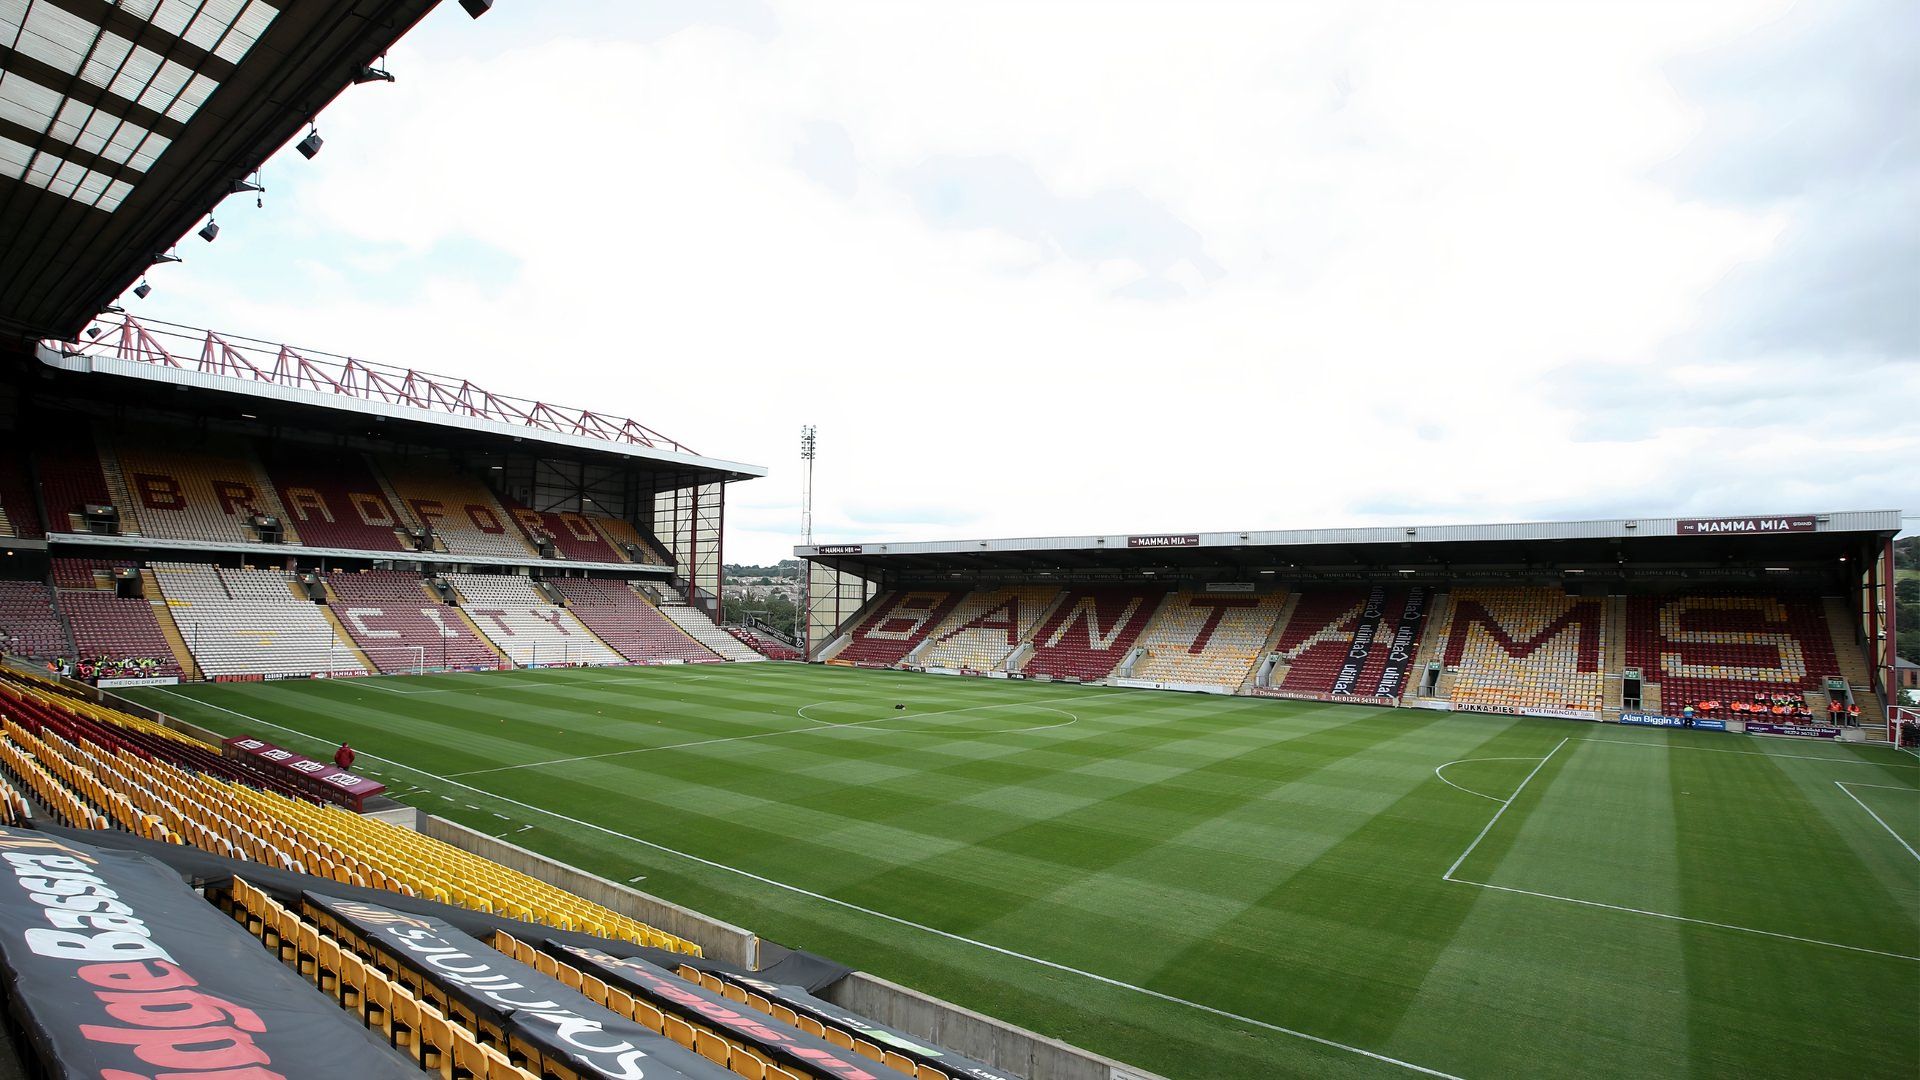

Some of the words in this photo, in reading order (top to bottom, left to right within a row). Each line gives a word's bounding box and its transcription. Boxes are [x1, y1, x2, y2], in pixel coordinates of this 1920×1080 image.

[134, 472, 598, 542] BRADFORD
[1697, 521, 1756, 532] MAMMA
[1760, 520, 1789, 531] MIA
[1138, 537, 1169, 546] MAMMA
[1171, 537, 1186, 545] MIA
[346, 606, 571, 639] CITY
[864, 591, 1807, 683] BANTAMS
[1352, 624, 1373, 650] utilita
[1393, 626, 1414, 651] utilita
[1335, 664, 1357, 690] utilita
[1379, 667, 1399, 692] utilita
[1622, 714, 1642, 722] Alan
[1643, 715, 1672, 725] Biggin
